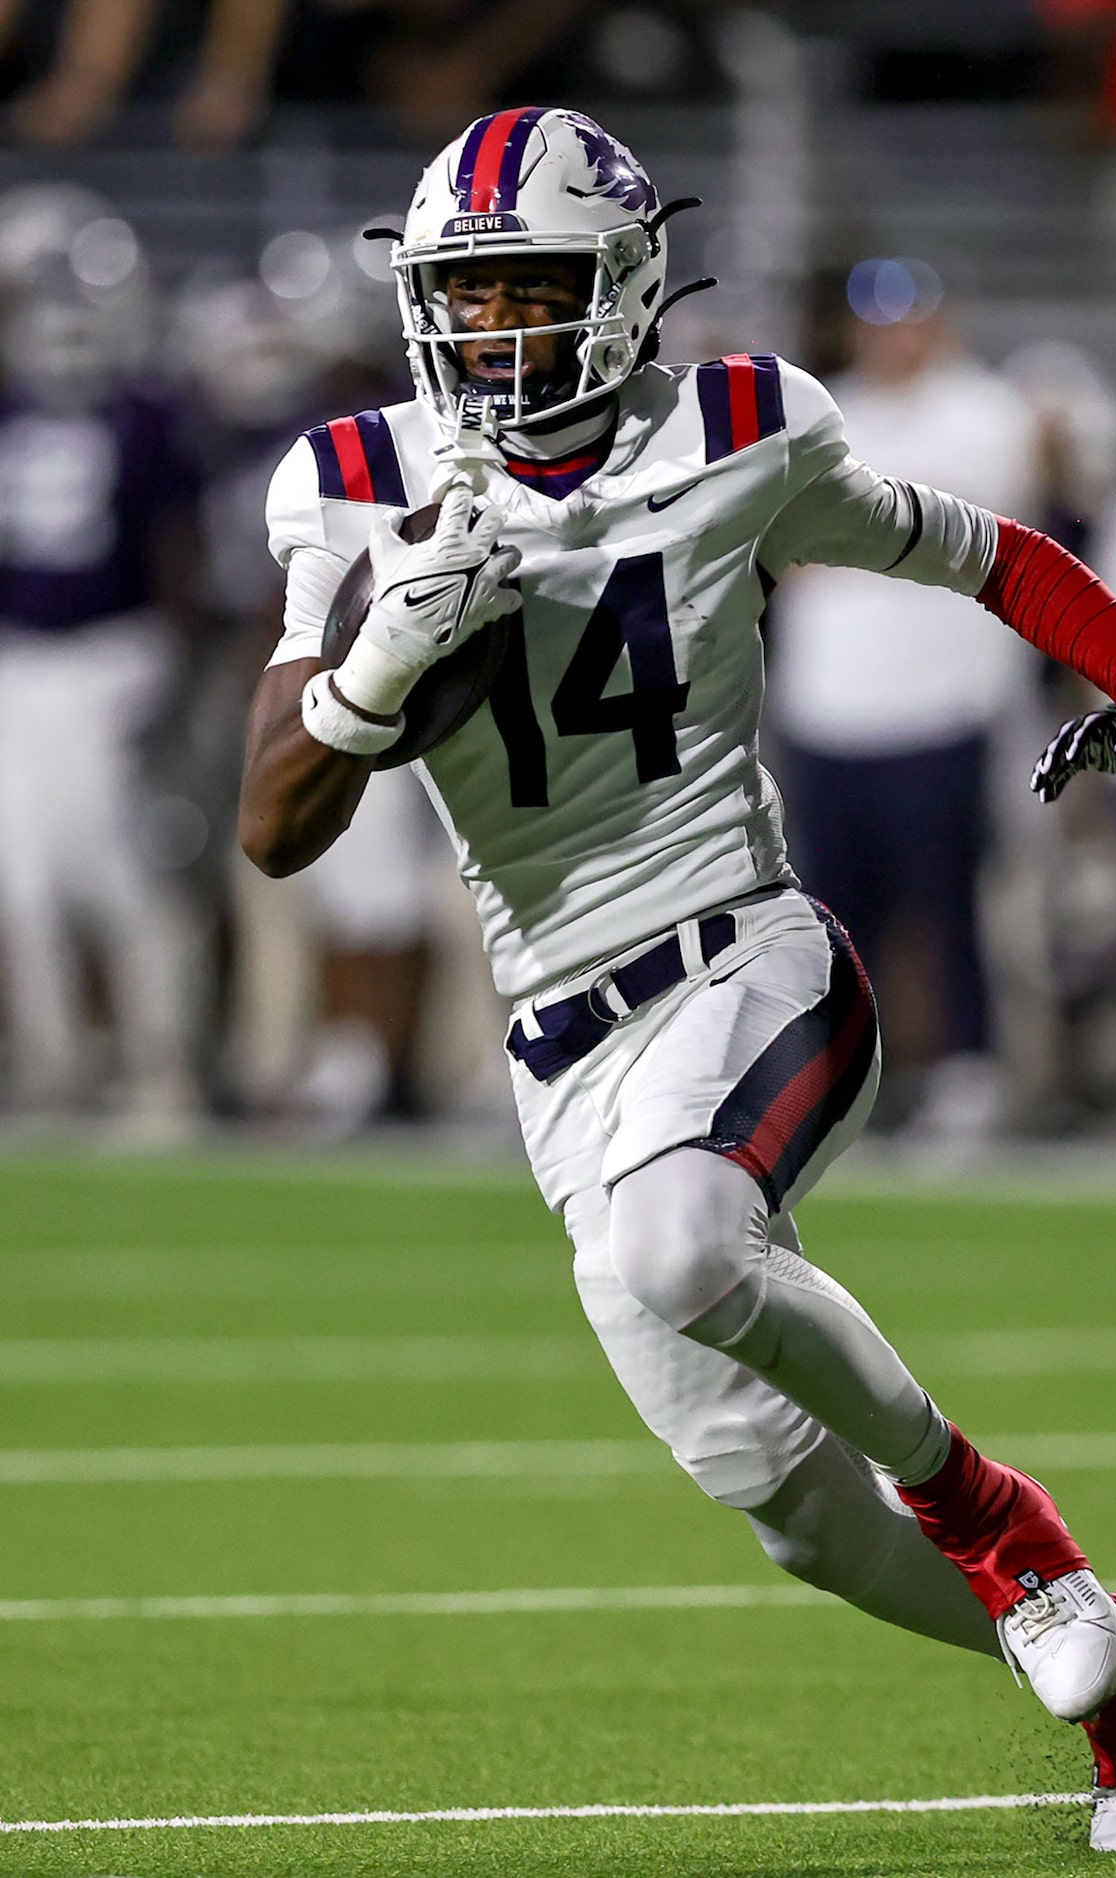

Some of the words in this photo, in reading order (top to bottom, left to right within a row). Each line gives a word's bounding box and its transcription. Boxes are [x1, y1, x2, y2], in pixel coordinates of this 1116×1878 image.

[454, 217, 502, 232] BELIEVE
[493, 395, 507, 405] WE
[508, 395, 530, 405] WLL
[488, 551, 691, 808] 14
